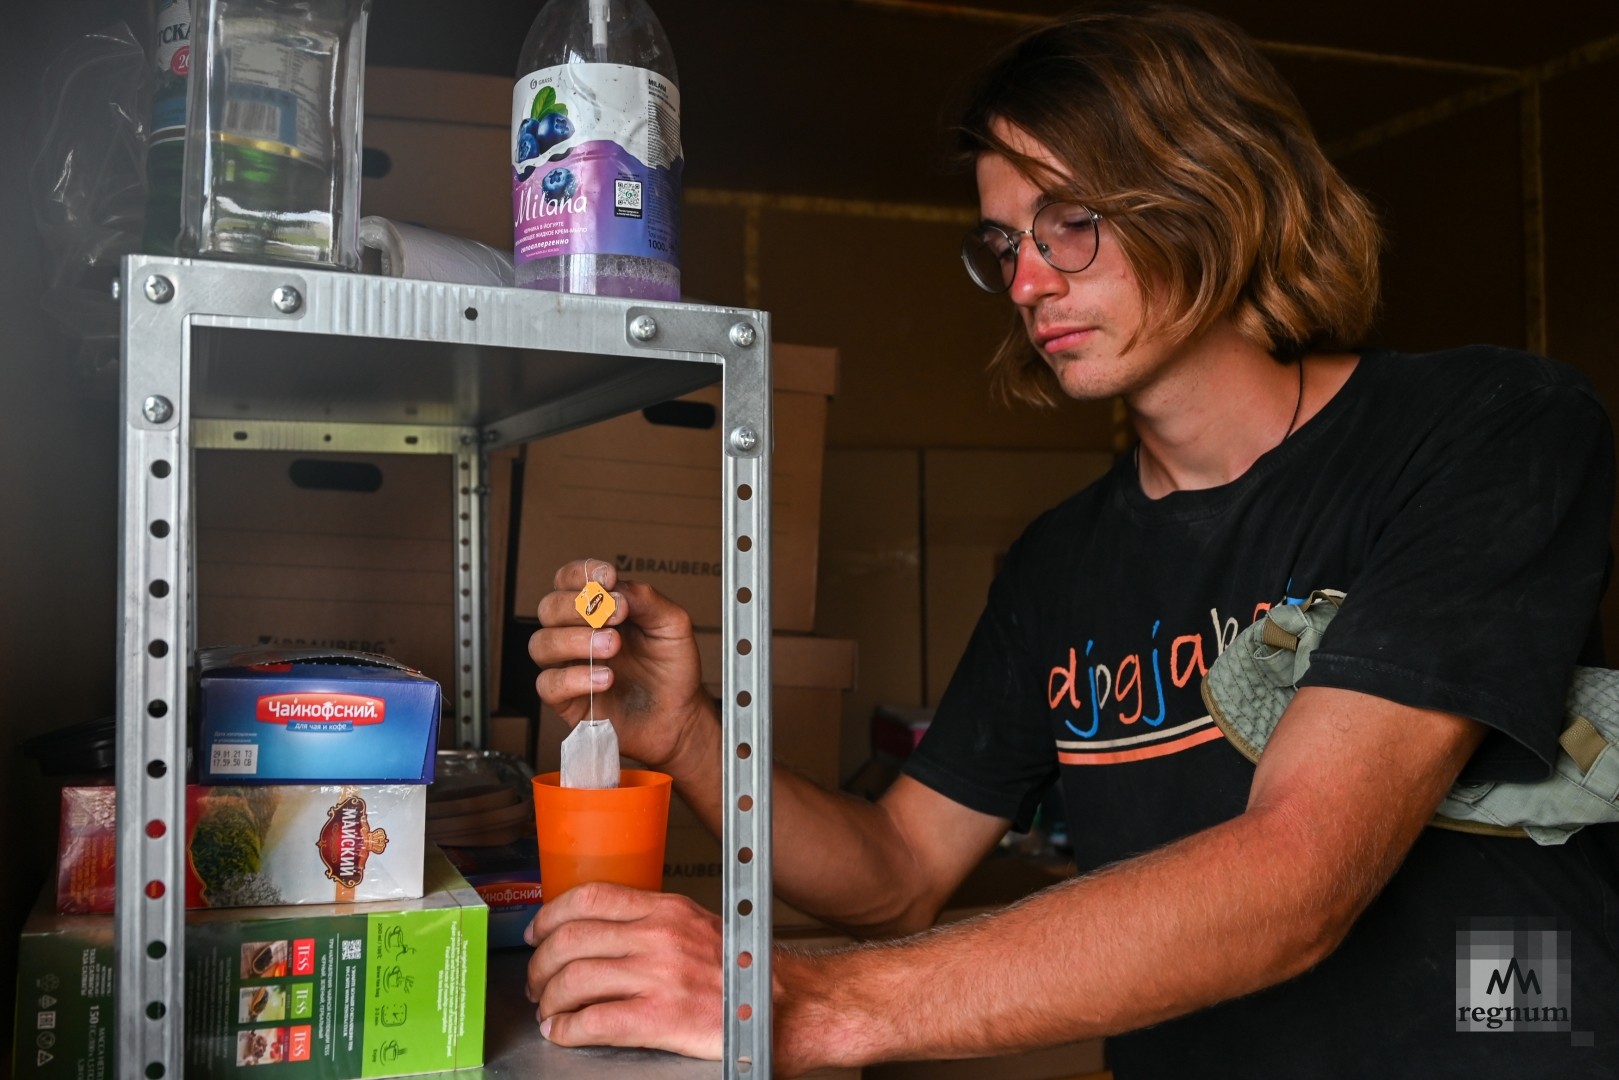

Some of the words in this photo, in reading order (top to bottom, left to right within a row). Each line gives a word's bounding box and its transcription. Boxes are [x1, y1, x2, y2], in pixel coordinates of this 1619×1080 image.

[515, 186, 587, 228] Milana
[268, 697, 374, 720] Чайкофский
[295, 722, 307, 730] для
[329, 722, 347, 731] кофе
[340, 808, 358, 876] МАЙСКИЙ
[297, 944, 311, 971] TESS
[294, 988, 309, 1015] TESS
[292, 1031, 307, 1057] TESS
